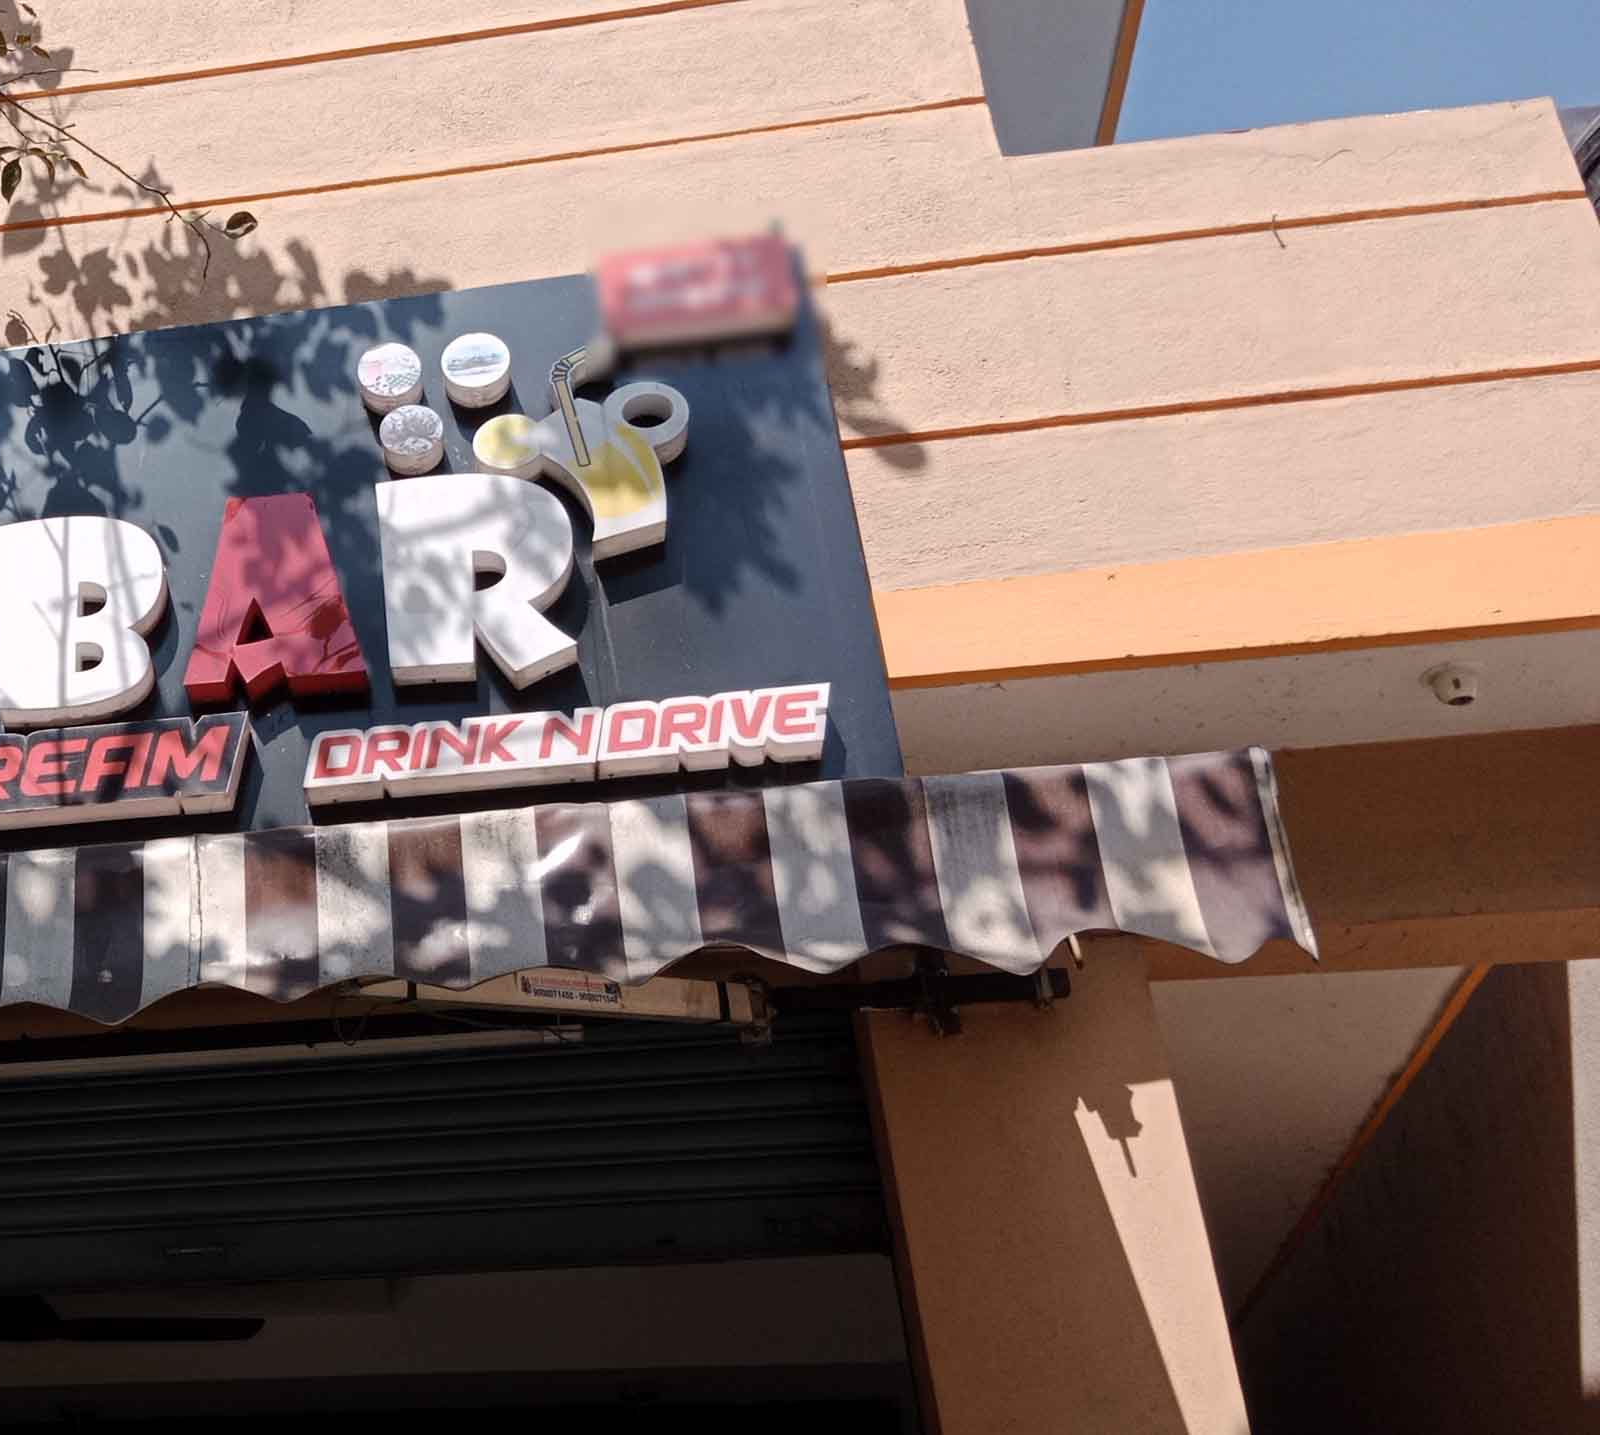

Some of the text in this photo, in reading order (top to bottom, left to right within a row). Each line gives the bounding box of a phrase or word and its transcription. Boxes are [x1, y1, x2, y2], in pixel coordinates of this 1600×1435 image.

[314, 690, 819, 779] DRINK N DRIVE
